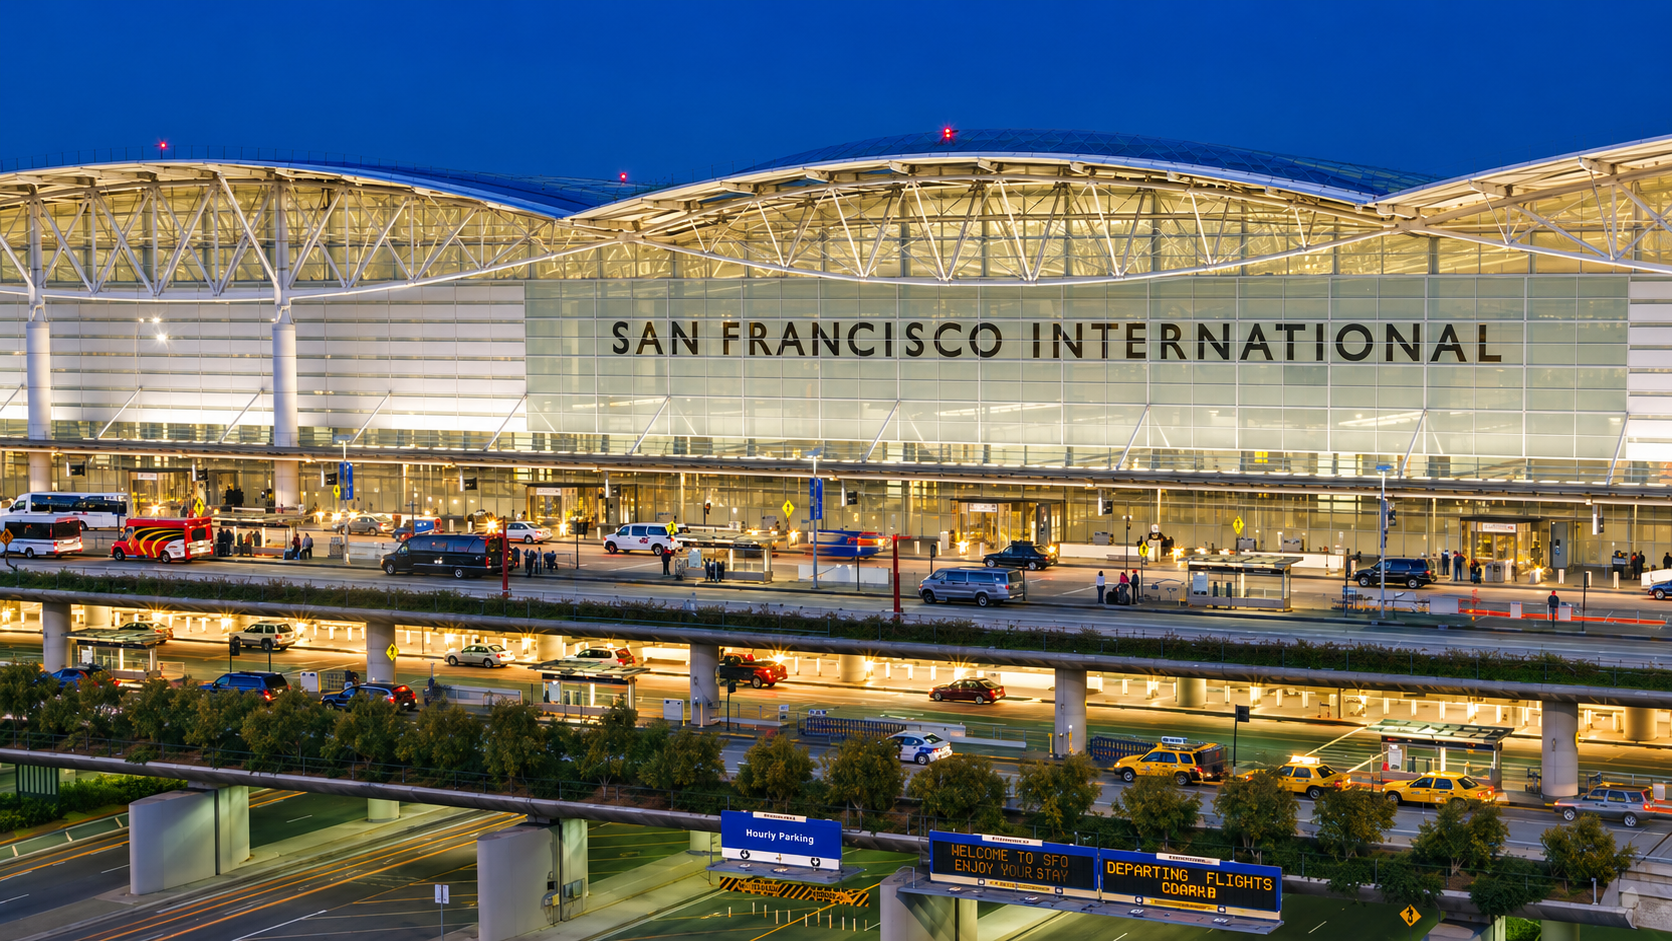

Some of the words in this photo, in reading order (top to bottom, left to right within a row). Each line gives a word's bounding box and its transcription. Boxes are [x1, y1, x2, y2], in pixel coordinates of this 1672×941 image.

[612, 321, 699, 356] SAN
[722, 321, 1003, 358] FRANCISCO
[1032, 322, 1502, 362] INTERNATIONAL
[746, 828, 777, 842] Hourly
[779, 832, 814, 846] Parking
[951, 844, 1009, 862] WELCOME
[1017, 851, 1034, 865] TO
[1043, 853, 1069, 868] SFO
[954, 859, 994, 875] ENJOY
[1000, 863, 1033, 879] YOUR
[1036, 867, 1069, 883] STAY
[1106, 861, 1189, 882] DEPARTING
[1206, 871, 1273, 891] FLIGHTS
